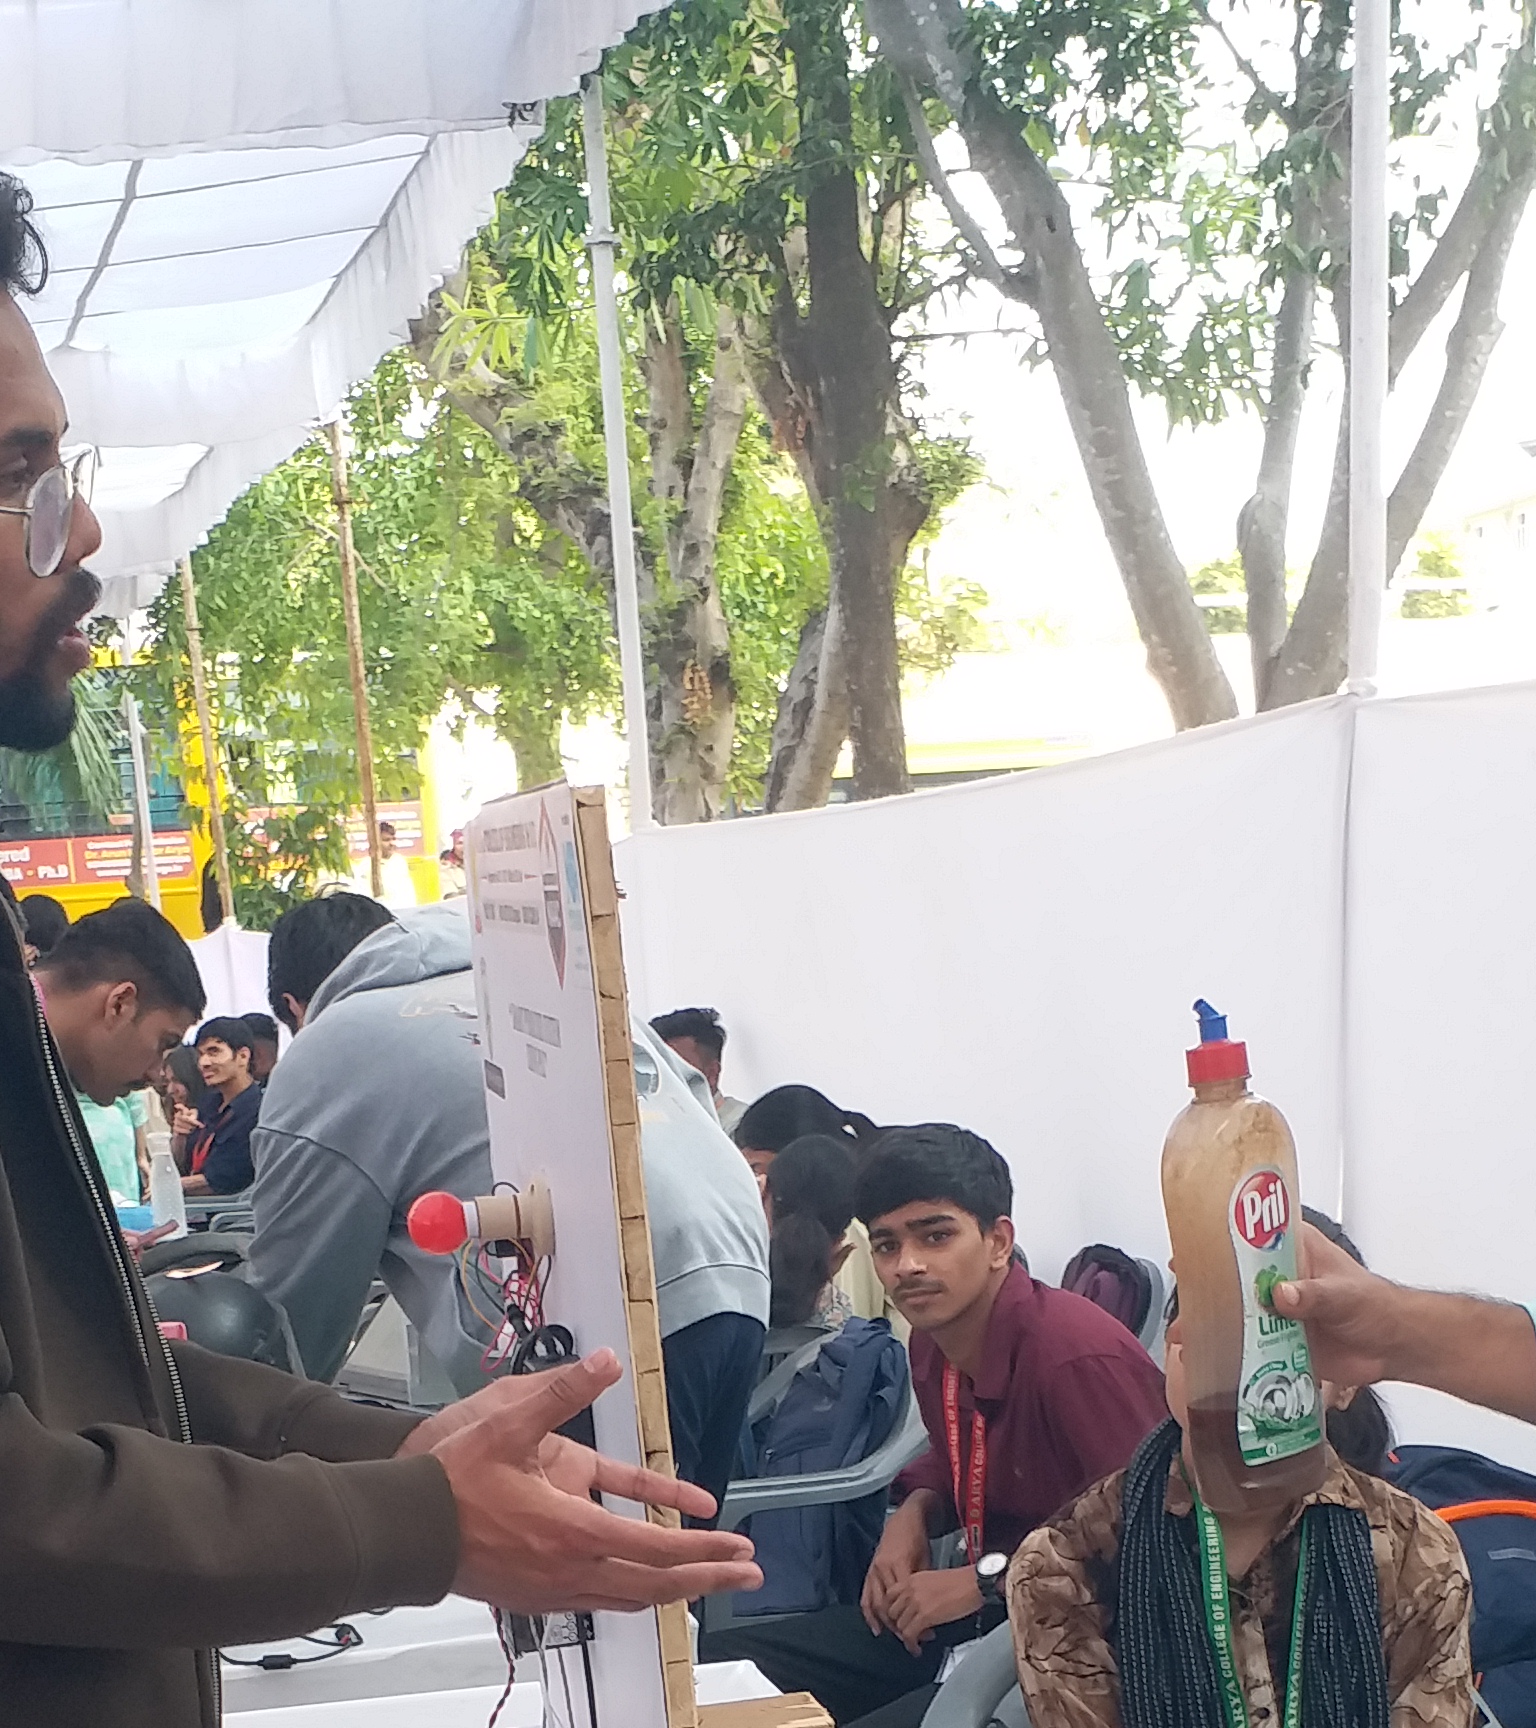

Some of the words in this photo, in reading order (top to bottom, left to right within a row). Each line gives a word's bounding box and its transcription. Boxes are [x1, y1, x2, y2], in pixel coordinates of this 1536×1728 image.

[1242, 1178, 1286, 1241] Pril
[971, 1469, 982, 1510] ARYA
[1204, 1516, 1224, 1600] ENGINEERING
[1212, 1600, 1226, 1621] OF
[1213, 1624, 1233, 1679] COLLEGE
